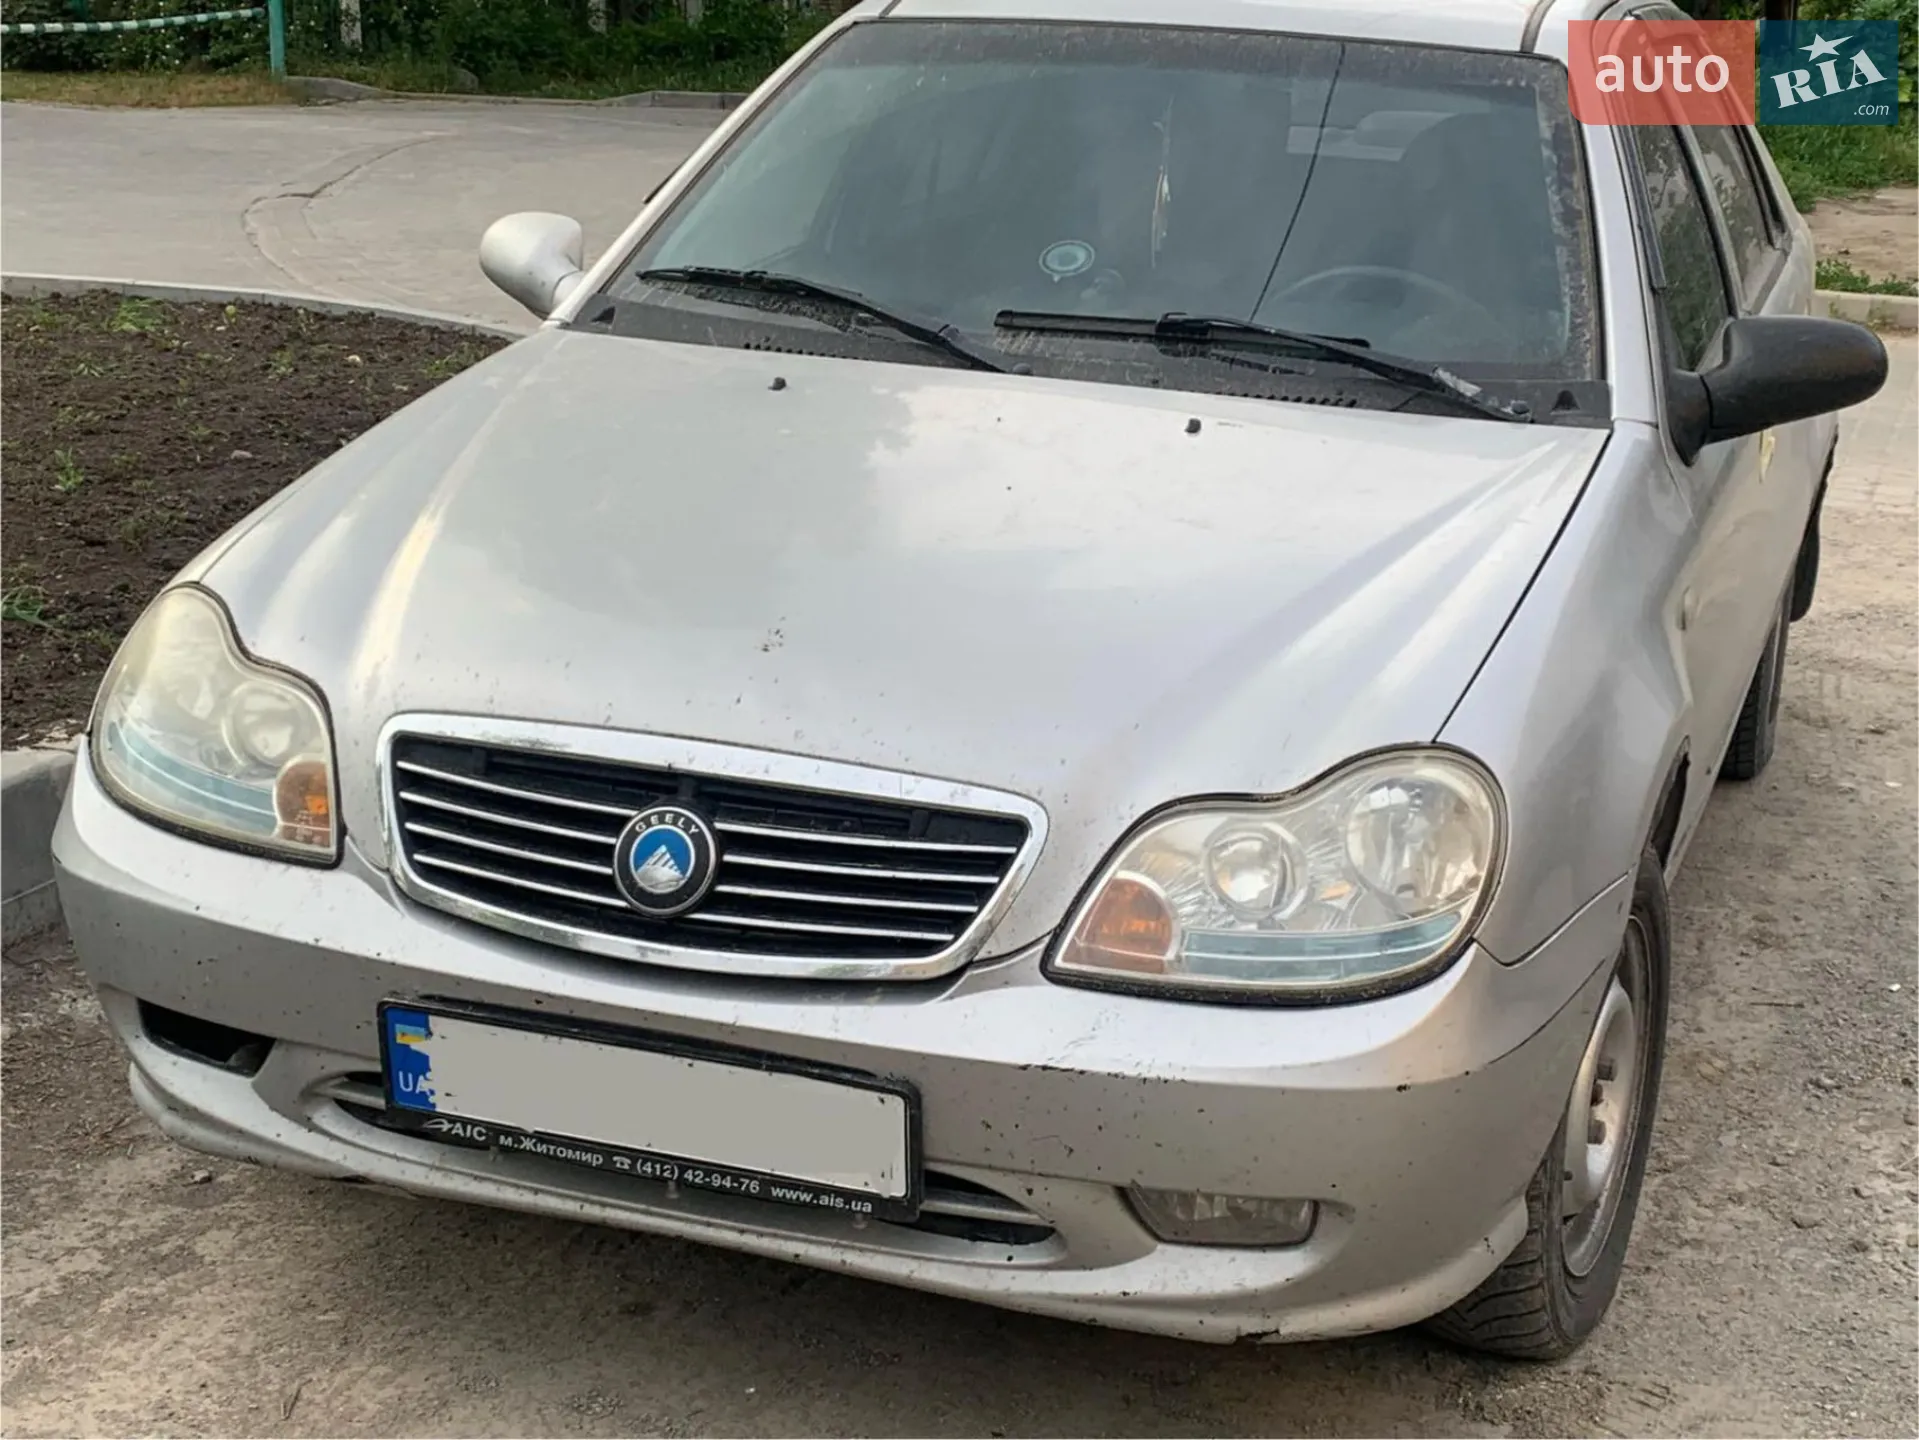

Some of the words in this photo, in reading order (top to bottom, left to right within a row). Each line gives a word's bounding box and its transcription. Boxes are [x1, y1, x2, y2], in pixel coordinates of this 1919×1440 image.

[635, 813, 700, 834] GEELY
[398, 1070, 432, 1097] UA
[636, 1158, 679, 1181] (412)
[683, 1168, 761, 1194] 42-94-76
[770, 1185, 872, 1213] www.ais.ua
